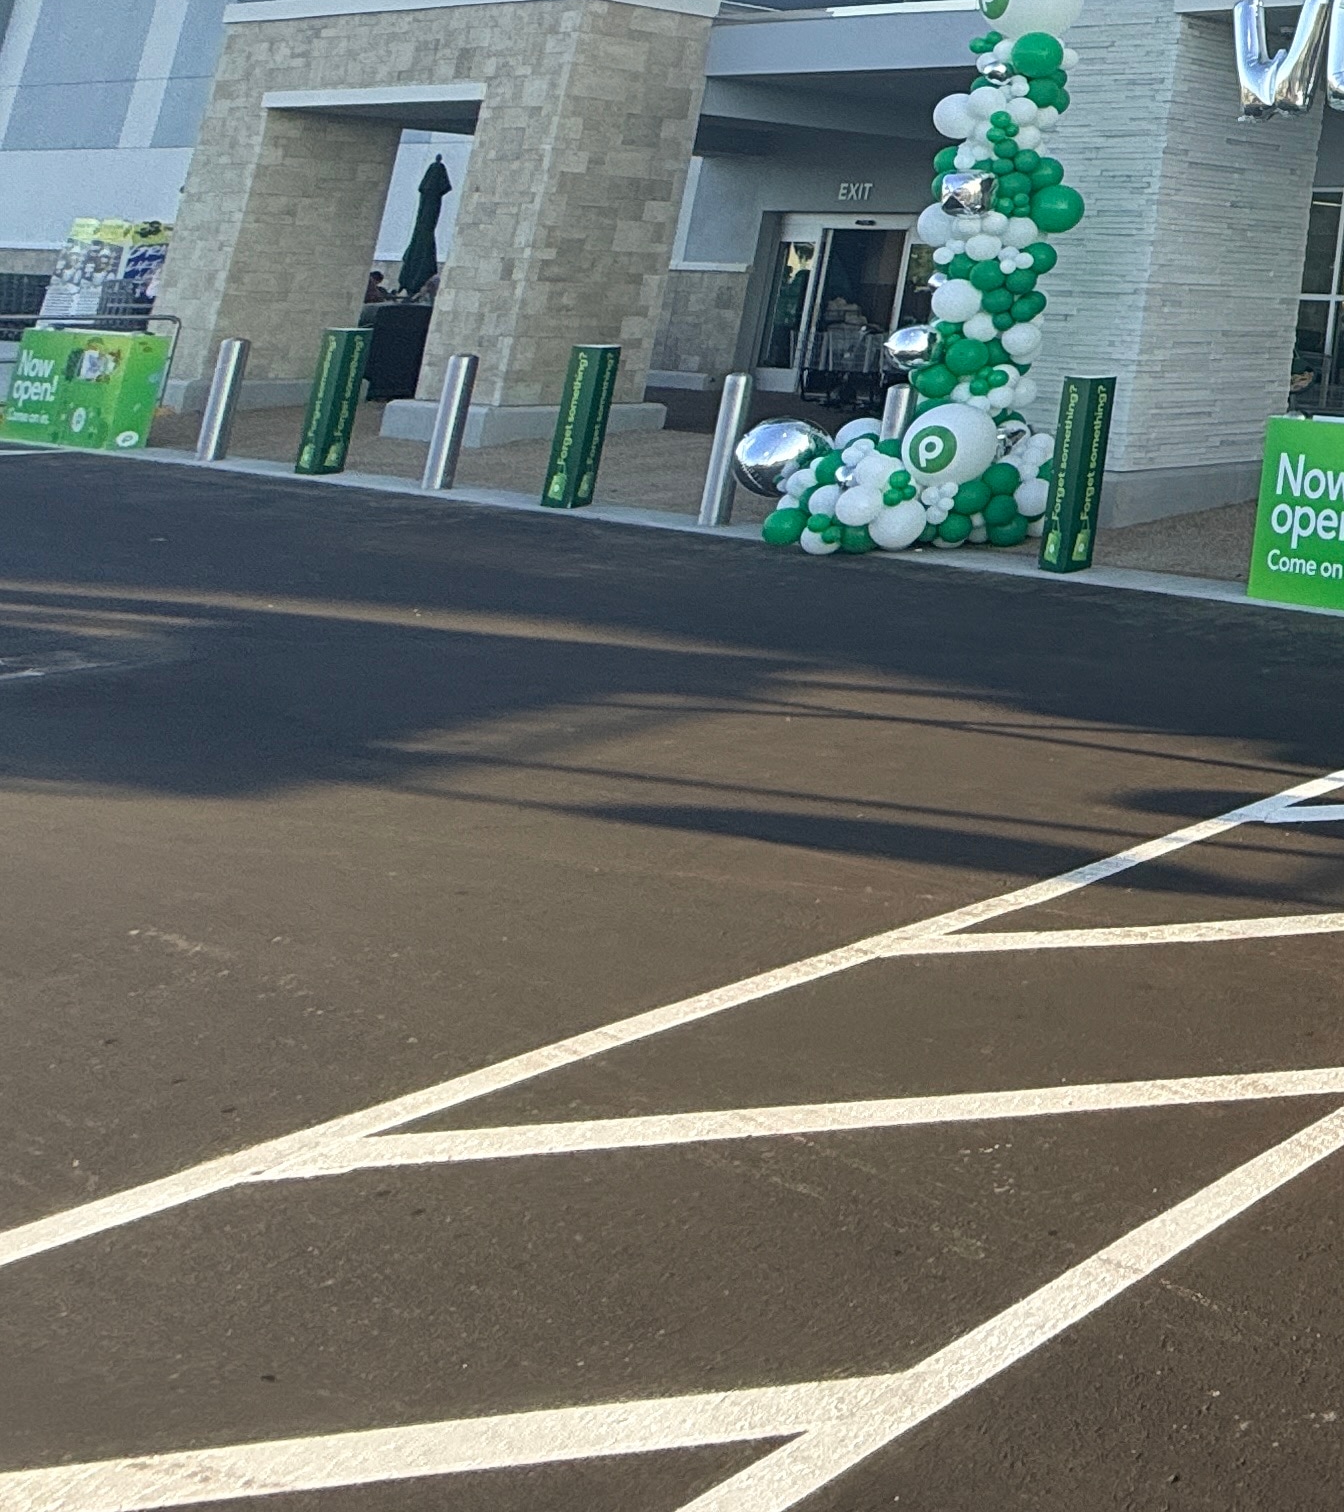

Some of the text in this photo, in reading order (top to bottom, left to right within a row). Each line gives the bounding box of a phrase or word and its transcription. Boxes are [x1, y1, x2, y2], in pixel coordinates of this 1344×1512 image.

[838, 182, 873, 200] EXIT
[13, 375, 59, 407] open!
[17, 349, 54, 377] Now
[556, 351, 588, 465] Forget something?
[586, 352, 614, 465] Forget something?
[1052, 384, 1079, 520] Forget something?
[1080, 384, 1107, 520] Forget something?
[1267, 549, 1316, 575] Come
[1320, 563, 1343, 579] on
